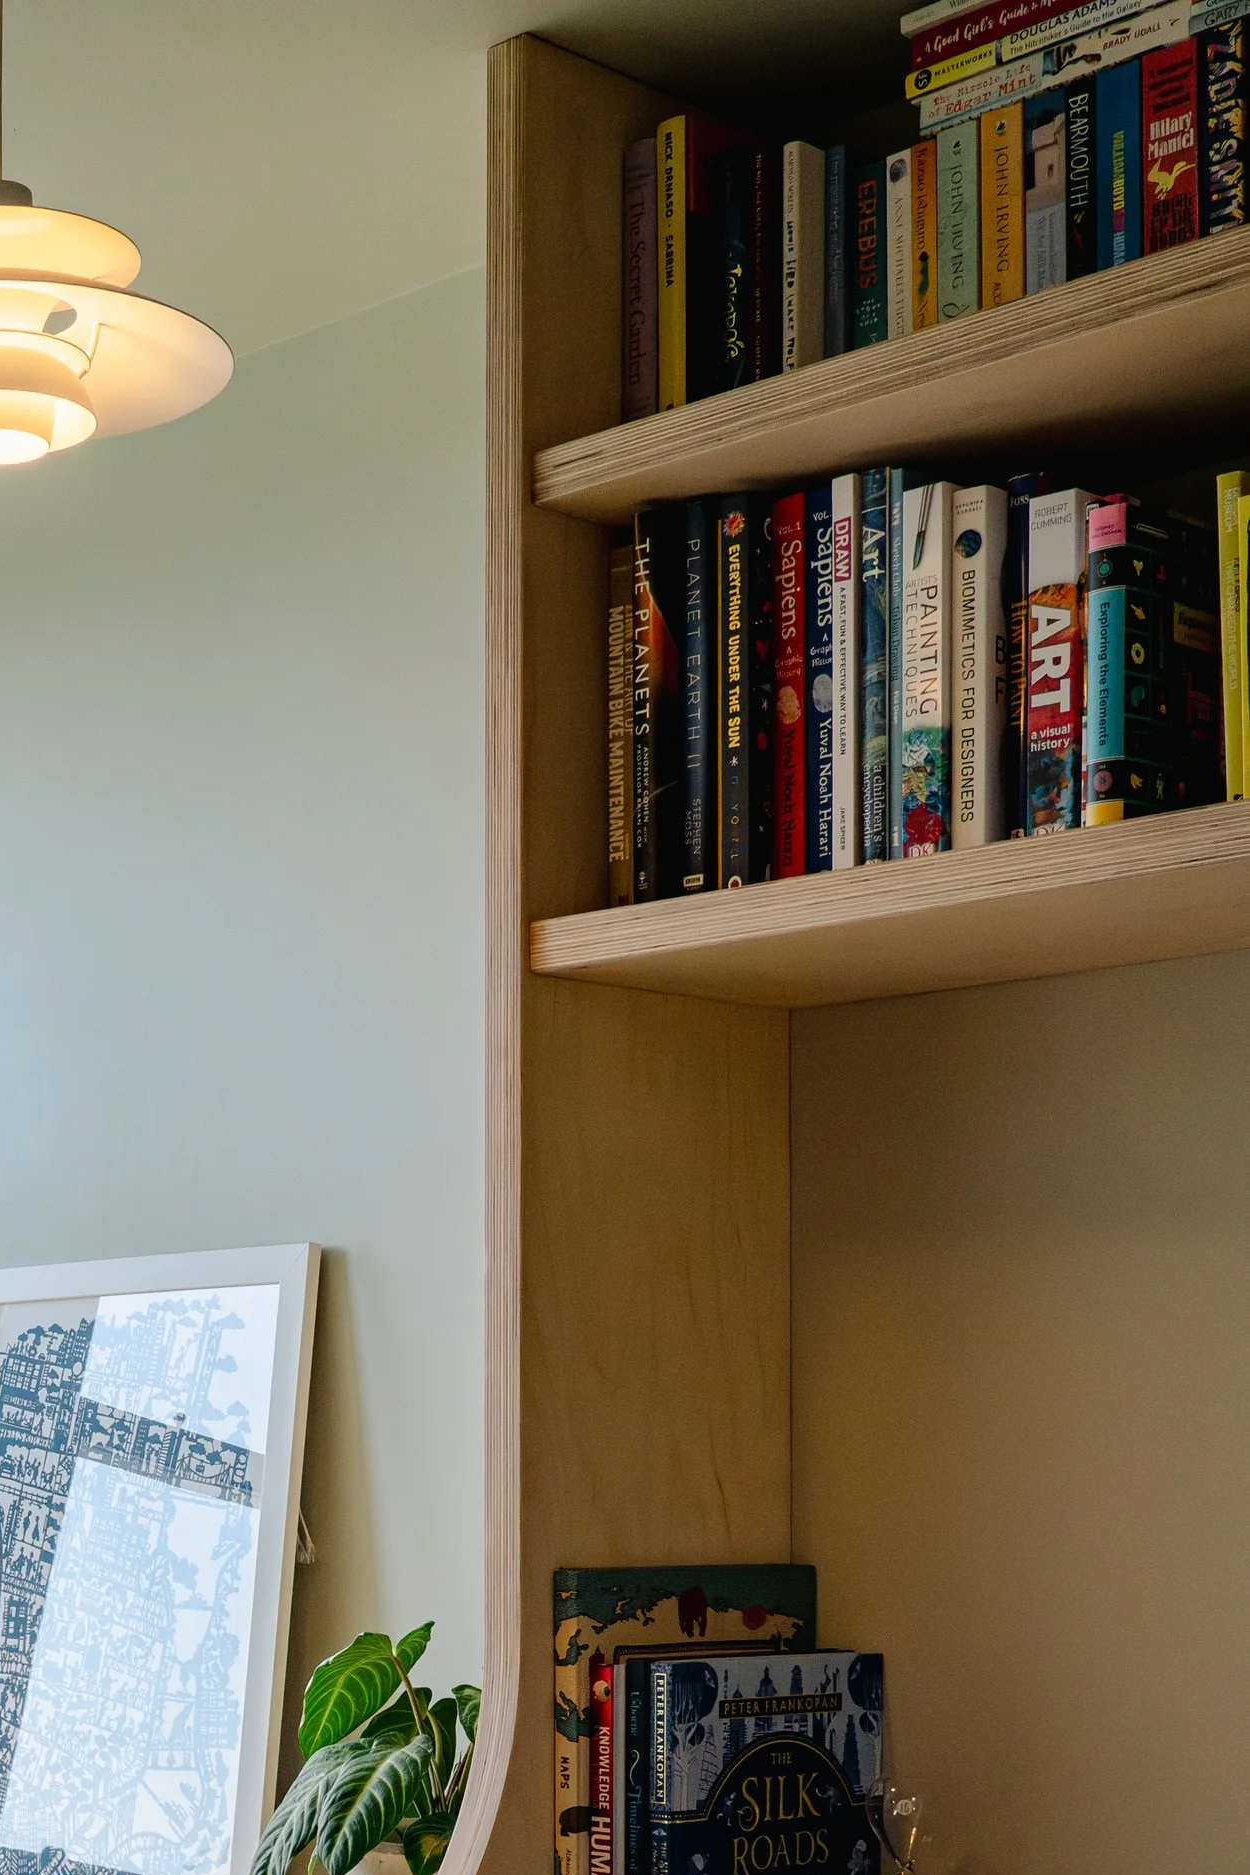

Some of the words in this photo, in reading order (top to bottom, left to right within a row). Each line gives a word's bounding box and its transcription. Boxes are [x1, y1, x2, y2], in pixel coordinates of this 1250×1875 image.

[933, 27, 960, 53] Good
[963, 15, 995, 41] Girl's
[999, 2, 1030, 26] Guide
[1010, 13, 1070, 45] DOUGLAS
[1071, 0, 1117, 21] ADAMS
[1010, 44, 1023, 56] The
[1069, 20, 1091, 34] Guide
[1092, 16, 1101, 25] to
[1102, 10, 1115, 21] the
[1116, 0, 1142, 17] Galaxy
[1102, 31, 1131, 51] BRADY
[1134, 22, 1162, 39] UDALL
[1204, 3, 1240, 27] GARY
[934, 49, 993, 78] MASTERWORKS
[944, 91, 991, 117] Edgar
[999, 73, 1037, 97] Mint
[664, 131, 673, 162] NICK
[1068, 92, 1090, 208] BEARMOUTH
[1147, 127, 1195, 161] Mantel
[1149, 110, 1193, 141] Hilary
[664, 166, 673, 219] DRNASO
[949, 163, 965, 213] JOHN
[994, 146, 1009, 197] JOHN
[1112, 179, 1125, 211] BOYD
[629, 200, 646, 238] The
[857, 179, 879, 291] EREBUS
[915, 193, 928, 250] Ishiguro
[995, 204, 1009, 274] IRVING
[629, 240, 646, 306] Secret
[664, 234, 674, 288] SABRINA
[950, 221, 965, 289] IRVING
[629, 309, 646, 388] Garden
[1031, 513, 1073, 532] CUMMING
[1034, 502, 1069, 519] ROBERT
[633, 537, 651, 593] THE
[834, 521, 850, 578] DRAW
[862, 525, 886, 582] Art
[686, 539, 702, 639] PLANET
[727, 543, 742, 631] EVERYTHING
[780, 539, 801, 639] Sapiens
[811, 527, 832, 628] Sapiens
[891, 572, 900, 597] Club
[904, 574, 938, 589] ARTISTS
[607, 604, 626, 696] MOUNTAIN
[919, 585, 938, 716] PAINTING
[961, 569, 976, 682] BIOMIMETICS
[1097, 601, 1111, 666] Exploring
[633, 608, 651, 736] PLANETS
[727, 634, 742, 683] UNDER
[904, 591, 918, 718] TECHNIQUES
[1030, 604, 1071, 713] ART
[1097, 668, 1110, 687] the
[607, 699, 626, 739] BIKE
[686, 655, 702, 741] EARTH
[727, 685, 742, 714] THE
[839, 713, 846, 725] TO
[961, 686, 975, 721] FOR
[1097, 690, 1110, 747] Elements
[727, 716, 742, 749] SUN
[781, 729, 797, 771] Yuval
[817, 717, 832, 759] Yuval
[1030, 730, 1039, 740] a
[1040, 722, 1071, 740] visual
[1030, 736, 1071, 754] history
[635, 743, 643, 796] PROFESSOR
[686, 751, 701, 769] II
[817, 763, 832, 805] Noah
[960, 727, 974, 824] DESIGNERS
[607, 741, 626, 863] MAINTENANCE
[635, 797, 643, 827] BRIAN
[781, 774, 797, 817] Noah
[861, 764, 872, 847] encyclopedia
[871, 775, 884, 843] children's
[635, 829, 643, 849] COX
[684, 810, 692, 846] MOSS
[692, 798, 701, 856] STEPHEN
[817, 808, 832, 858] Harari
[656, 1678, 664, 1716] PETER
[724, 1701, 761, 1716] PETER
[764, 1695, 838, 1713] FRANKOPAN
[560, 1756, 570, 1789] MAPS
[597, 1726, 610, 1810] KNOWLEDGE
[656, 1719, 664, 1799] FRANKOPAN
[769, 1752, 793, 1765] THE
[738, 1772, 822, 1832] SILK
